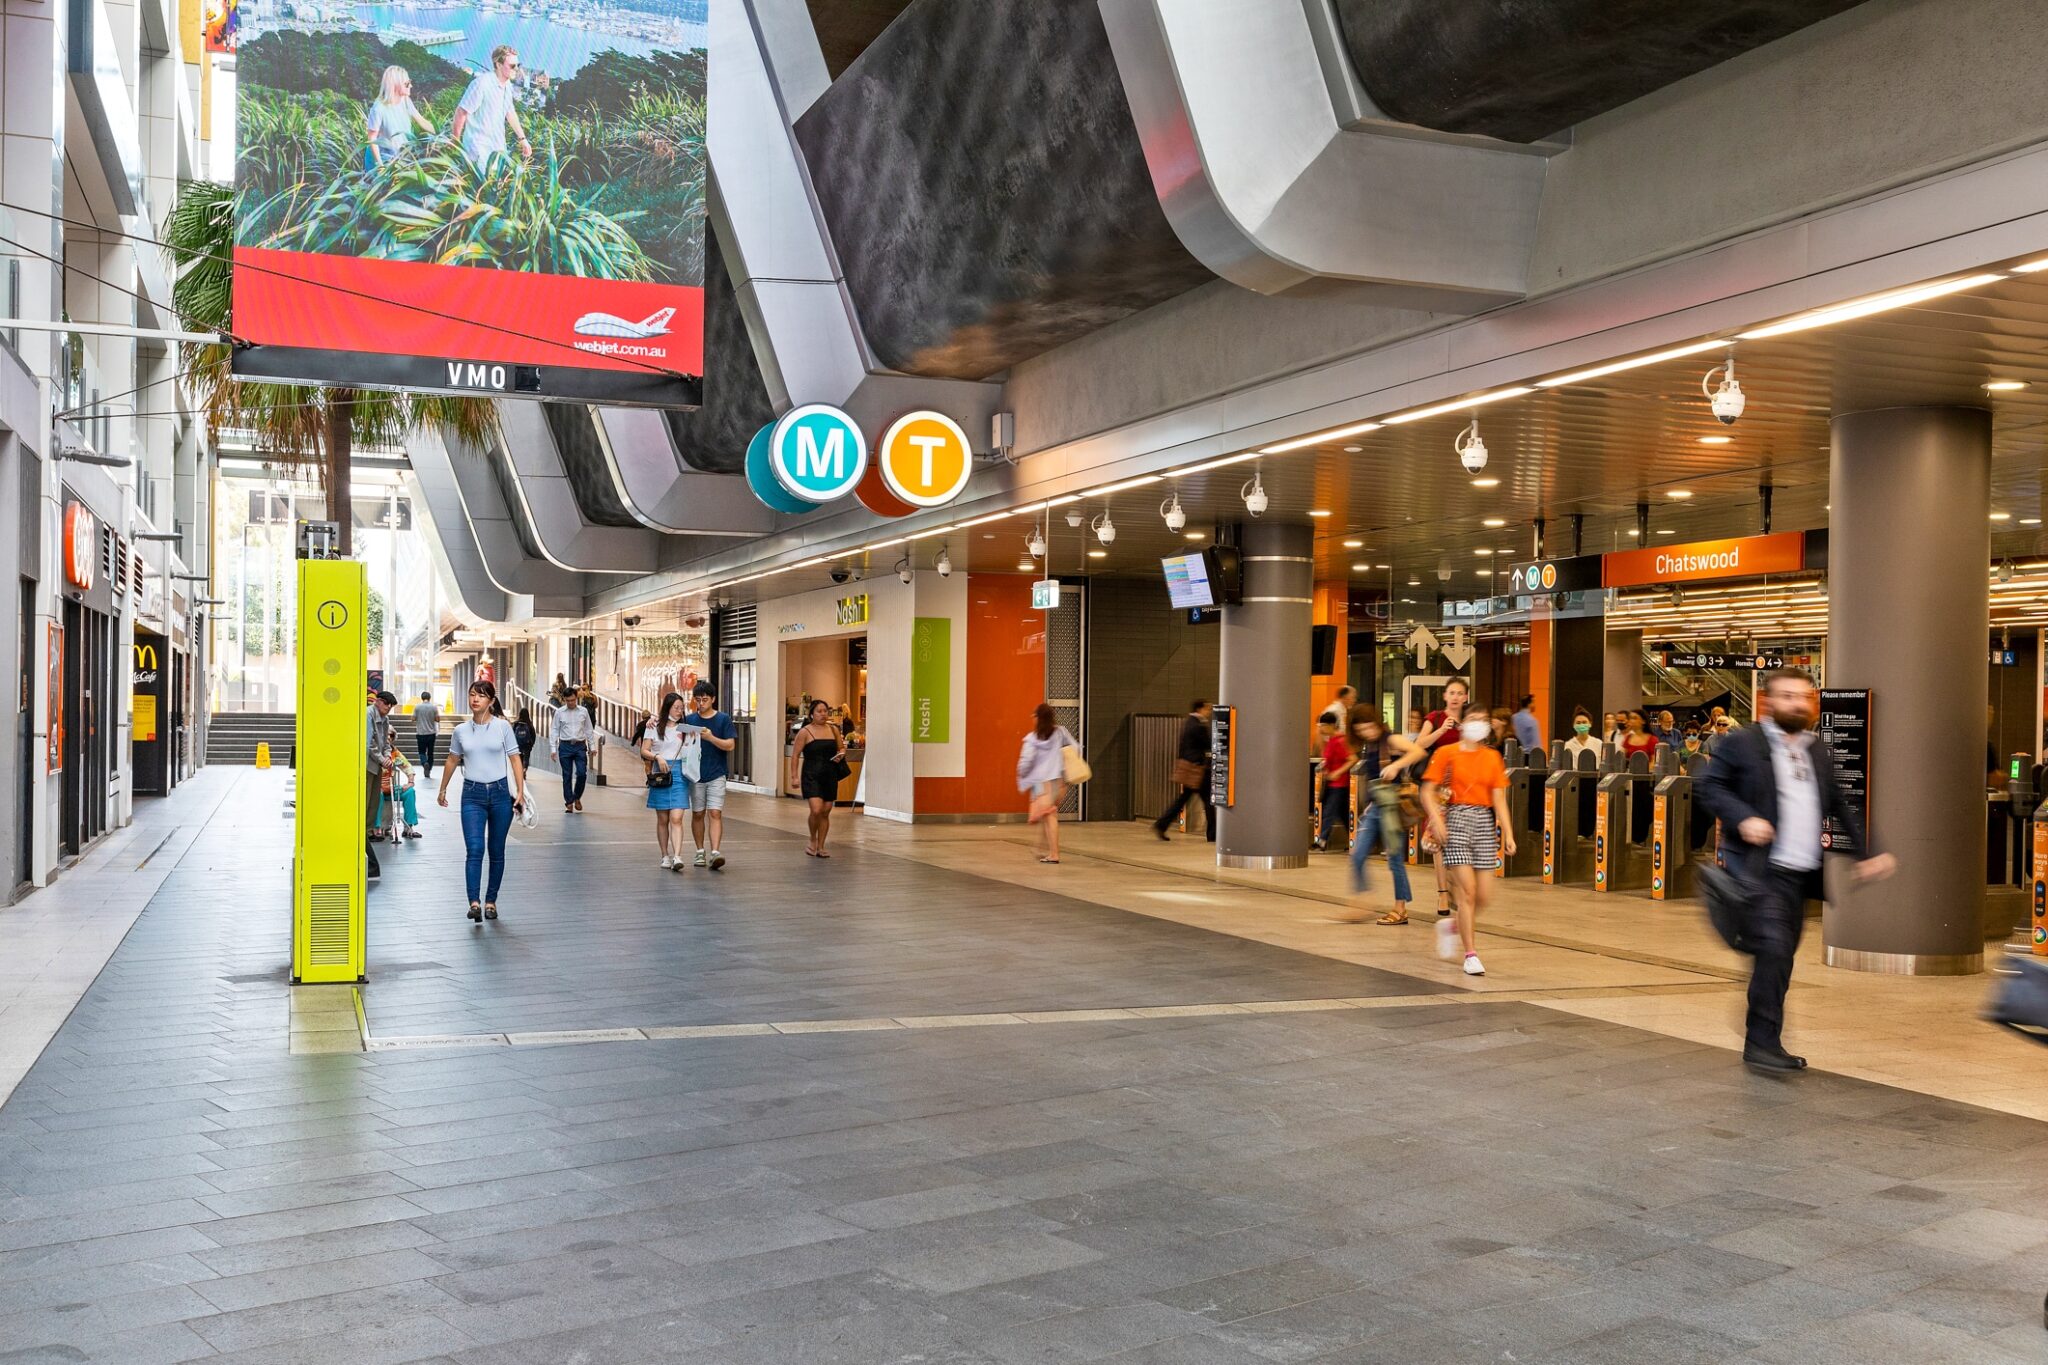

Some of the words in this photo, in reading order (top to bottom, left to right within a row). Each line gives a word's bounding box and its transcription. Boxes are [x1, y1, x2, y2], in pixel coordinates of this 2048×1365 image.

[573, 341, 667, 357] webjet.com.au
[447, 362, 506, 389] VMO
[796, 426, 845, 479] M
[909, 435, 946, 487] T
[1655, 547, 1739, 575] Chatswood
[1529, 570, 1538, 586] M
[1545, 569, 1553, 584] T
[836, 594, 868, 626] Nashi
[1708, 656, 1714, 666] 3
[1735, 660, 1754, 668] Hornsby
[1767, 658, 1773, 668] 4
[919, 698, 931, 738] Nashi
